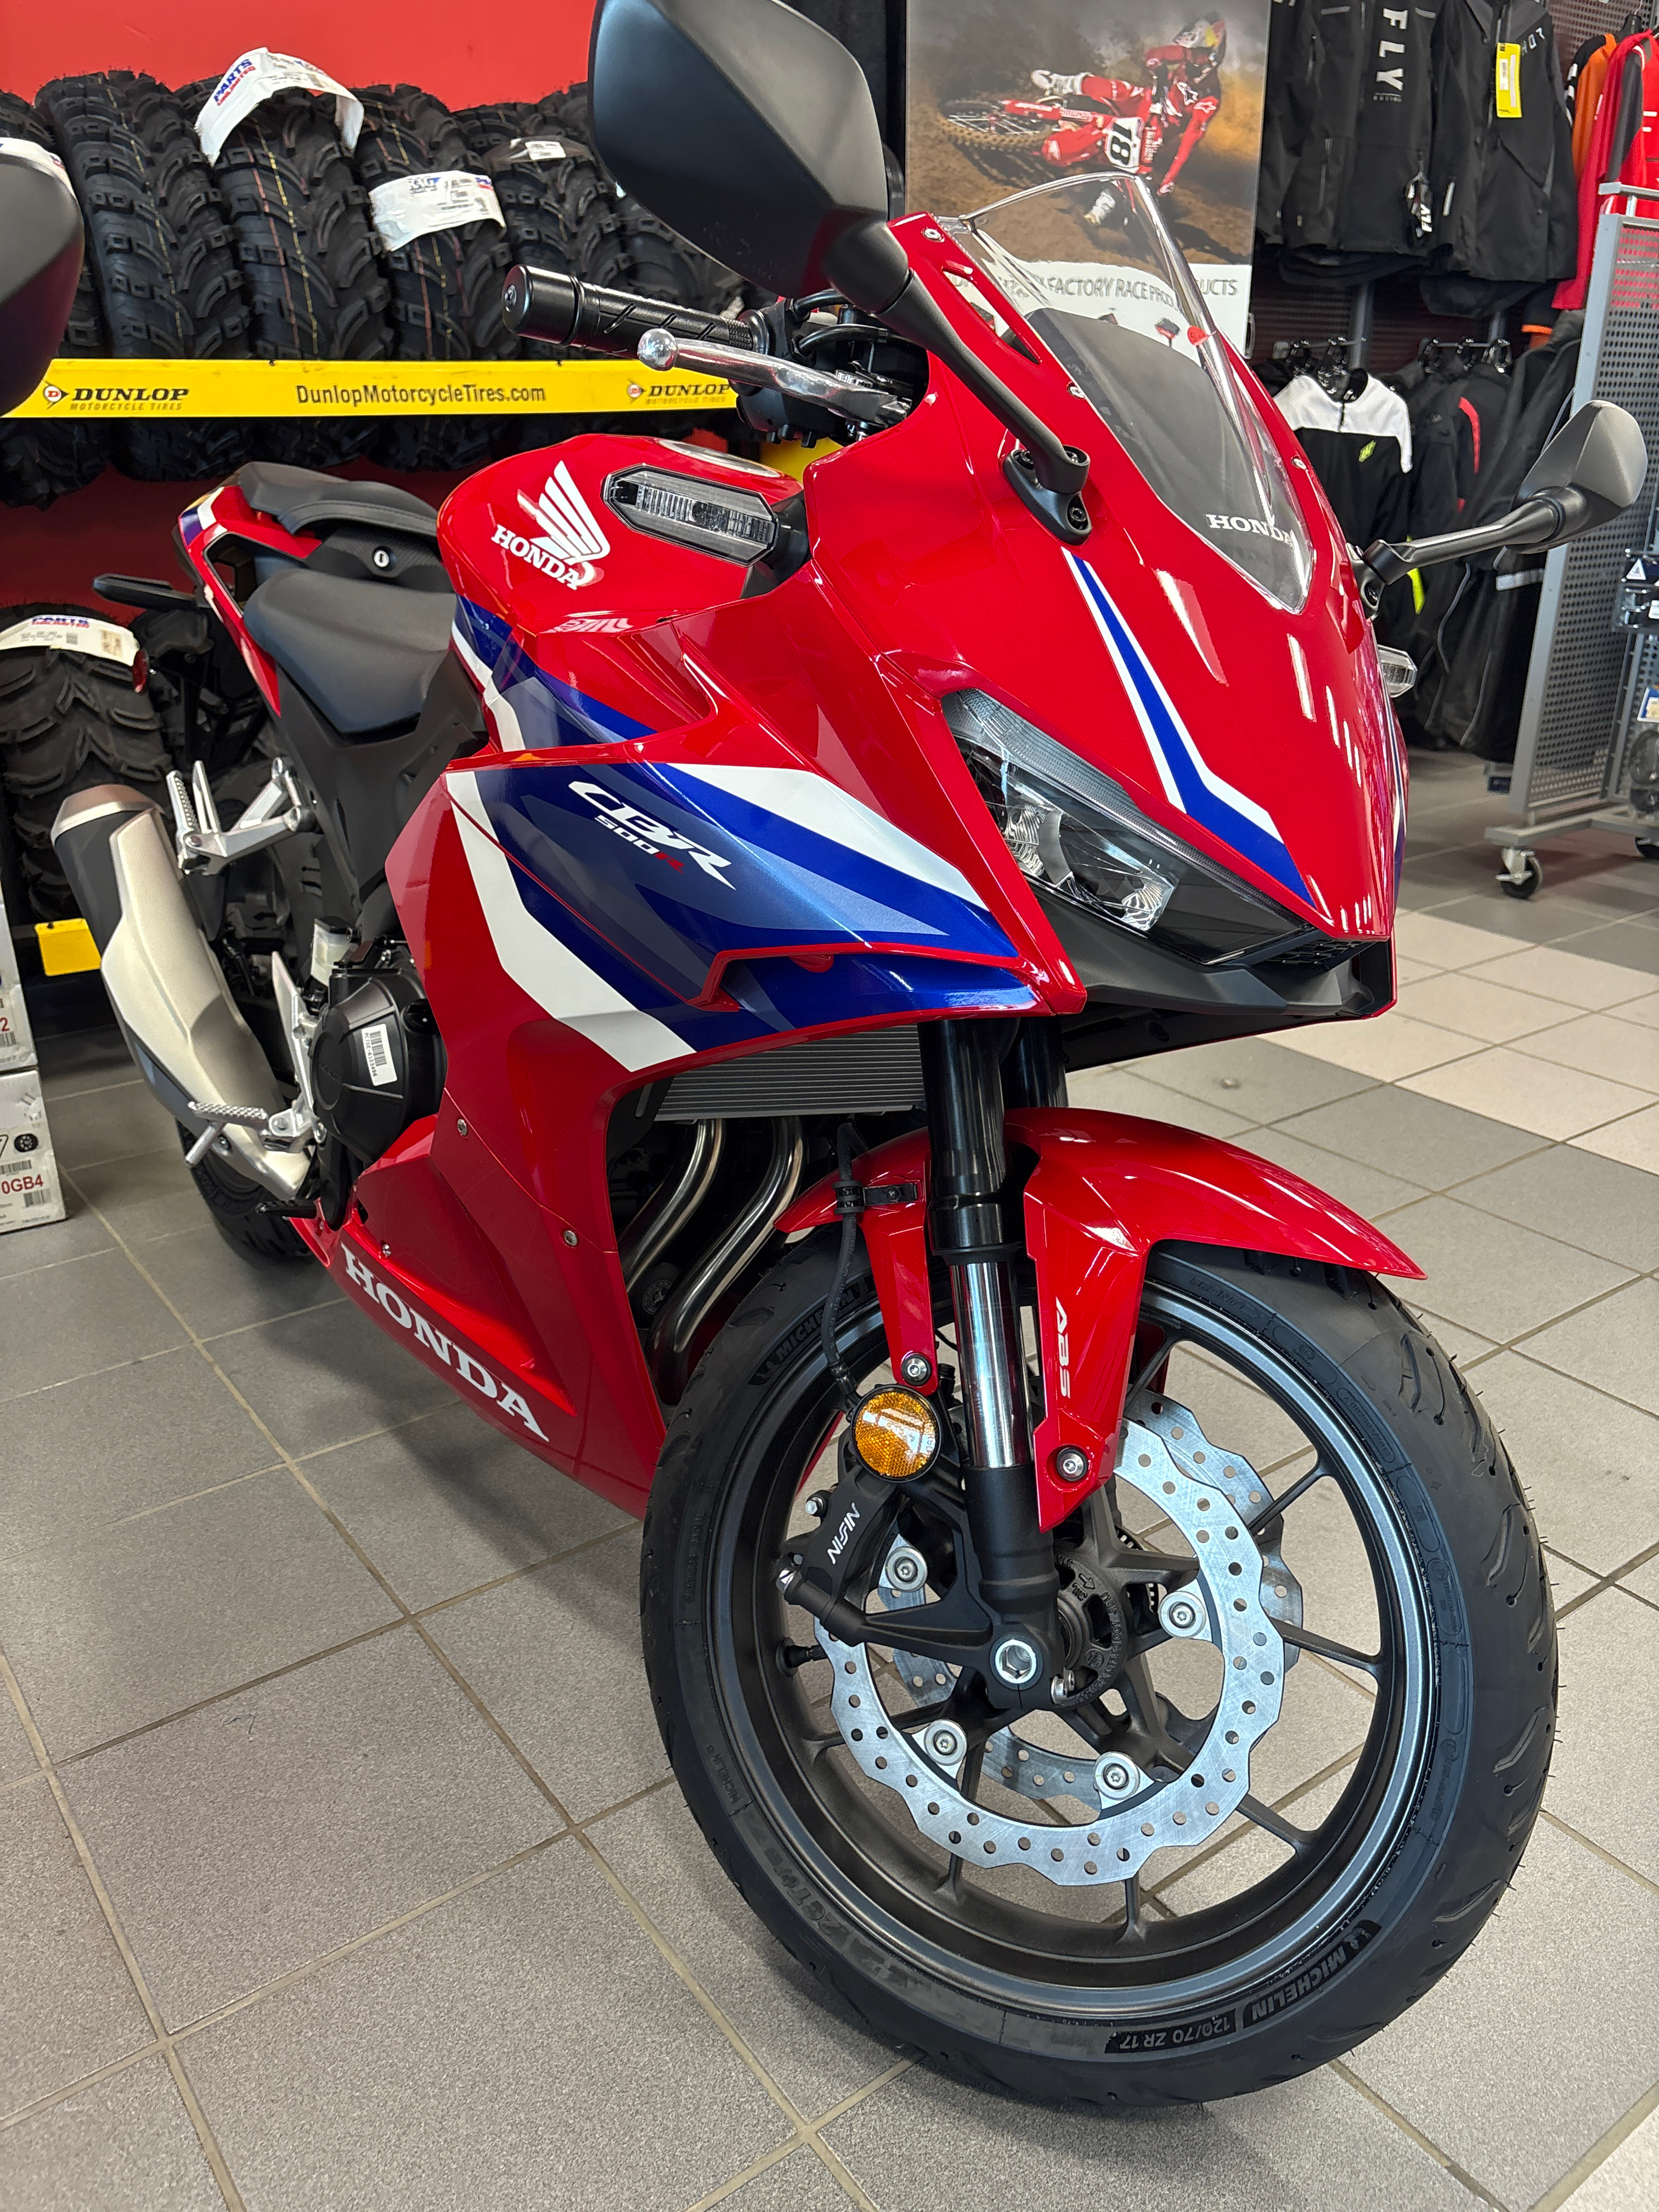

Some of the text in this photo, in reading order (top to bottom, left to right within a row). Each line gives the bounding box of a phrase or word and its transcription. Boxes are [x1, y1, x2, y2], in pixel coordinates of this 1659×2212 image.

[1376, 8, 1408, 92] FLY
[213, 58, 253, 103] PARTS
[1109, 122, 1132, 165] 18
[1047, 276, 1114, 297] FACTORY
[1115, 278, 1148, 300] RACE
[69, 402, 183, 411] MOTORCYCLE TIRES
[72, 387, 189, 402] DUNLOP
[296, 384, 546, 407] DunlopMotorcycleTires.com
[647, 383, 730, 397] DUNLOP
[1205, 514, 1295, 548] HONDA
[490, 524, 578, 591] HONDA
[568, 781, 737, 891] CBR
[594, 815, 685, 875] 500R
[364, 1032, 378, 1077] PC70E-6103496
[341, 1242, 550, 1443] HONDA
[776, 1288, 856, 1362] MICHEN
[1056, 1296, 1071, 1399] ABS
[713, 1753, 741, 1804] MICHELIN
[1251, 1945, 1347, 2022] MICHELIN
[1119, 2016, 1231, 2050] 120/70 ZR 17
